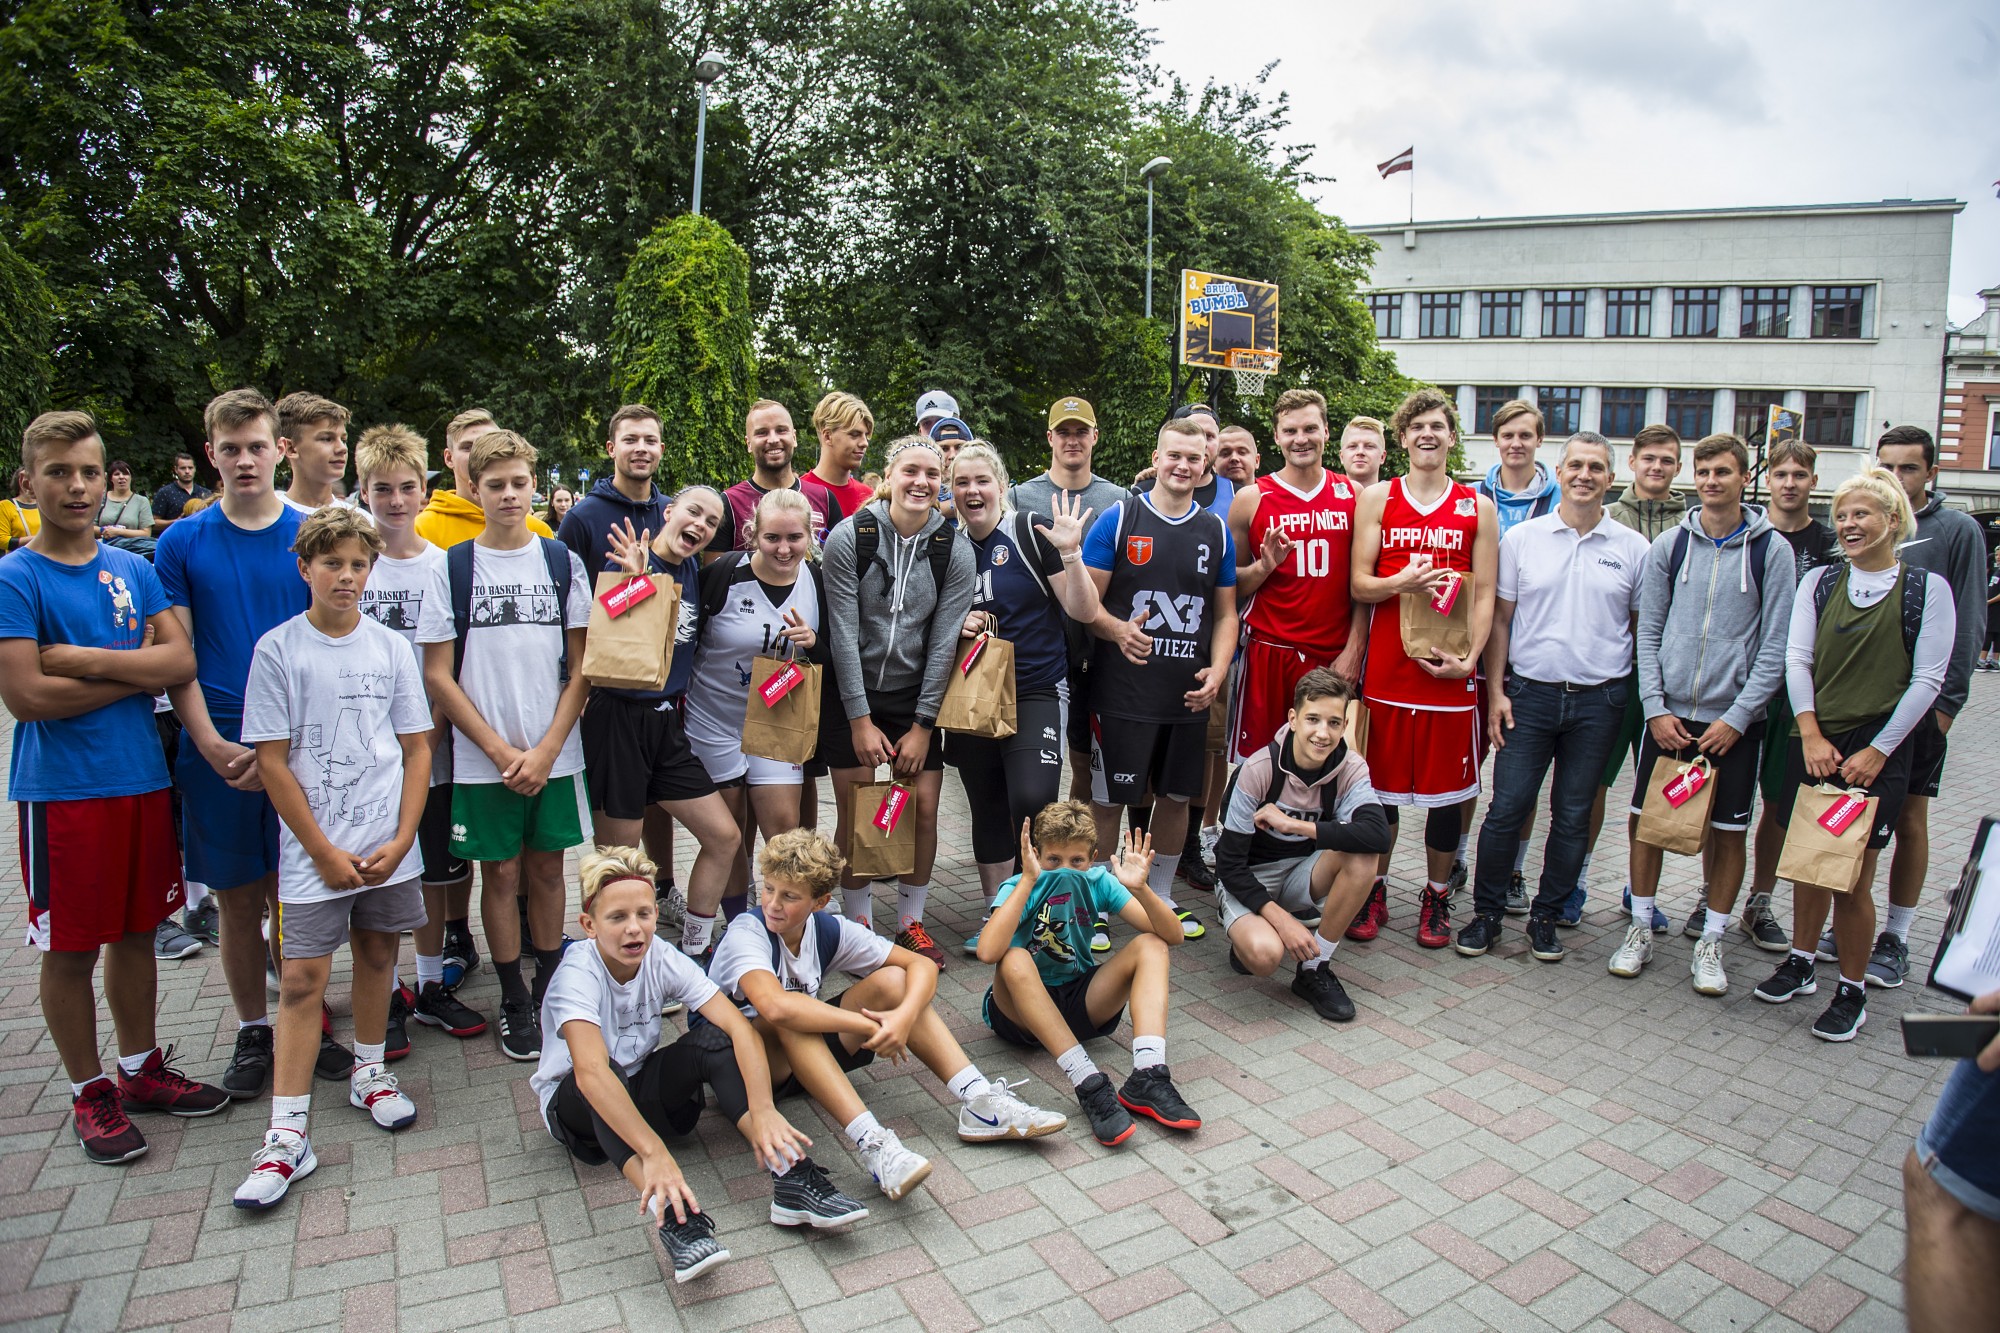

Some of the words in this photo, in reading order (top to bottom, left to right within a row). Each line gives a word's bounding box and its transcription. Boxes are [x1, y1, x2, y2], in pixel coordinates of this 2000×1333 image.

[1190, 293, 1248, 314] BUMBA
[1197, 544, 1210, 575] 2
[1293, 539, 1330, 577] 10
[377, 589, 409, 601] BASKET
[488, 583, 522, 595] BASKET
[762, 623, 790, 656] 14
[765, 667, 796, 697] KURZEME
